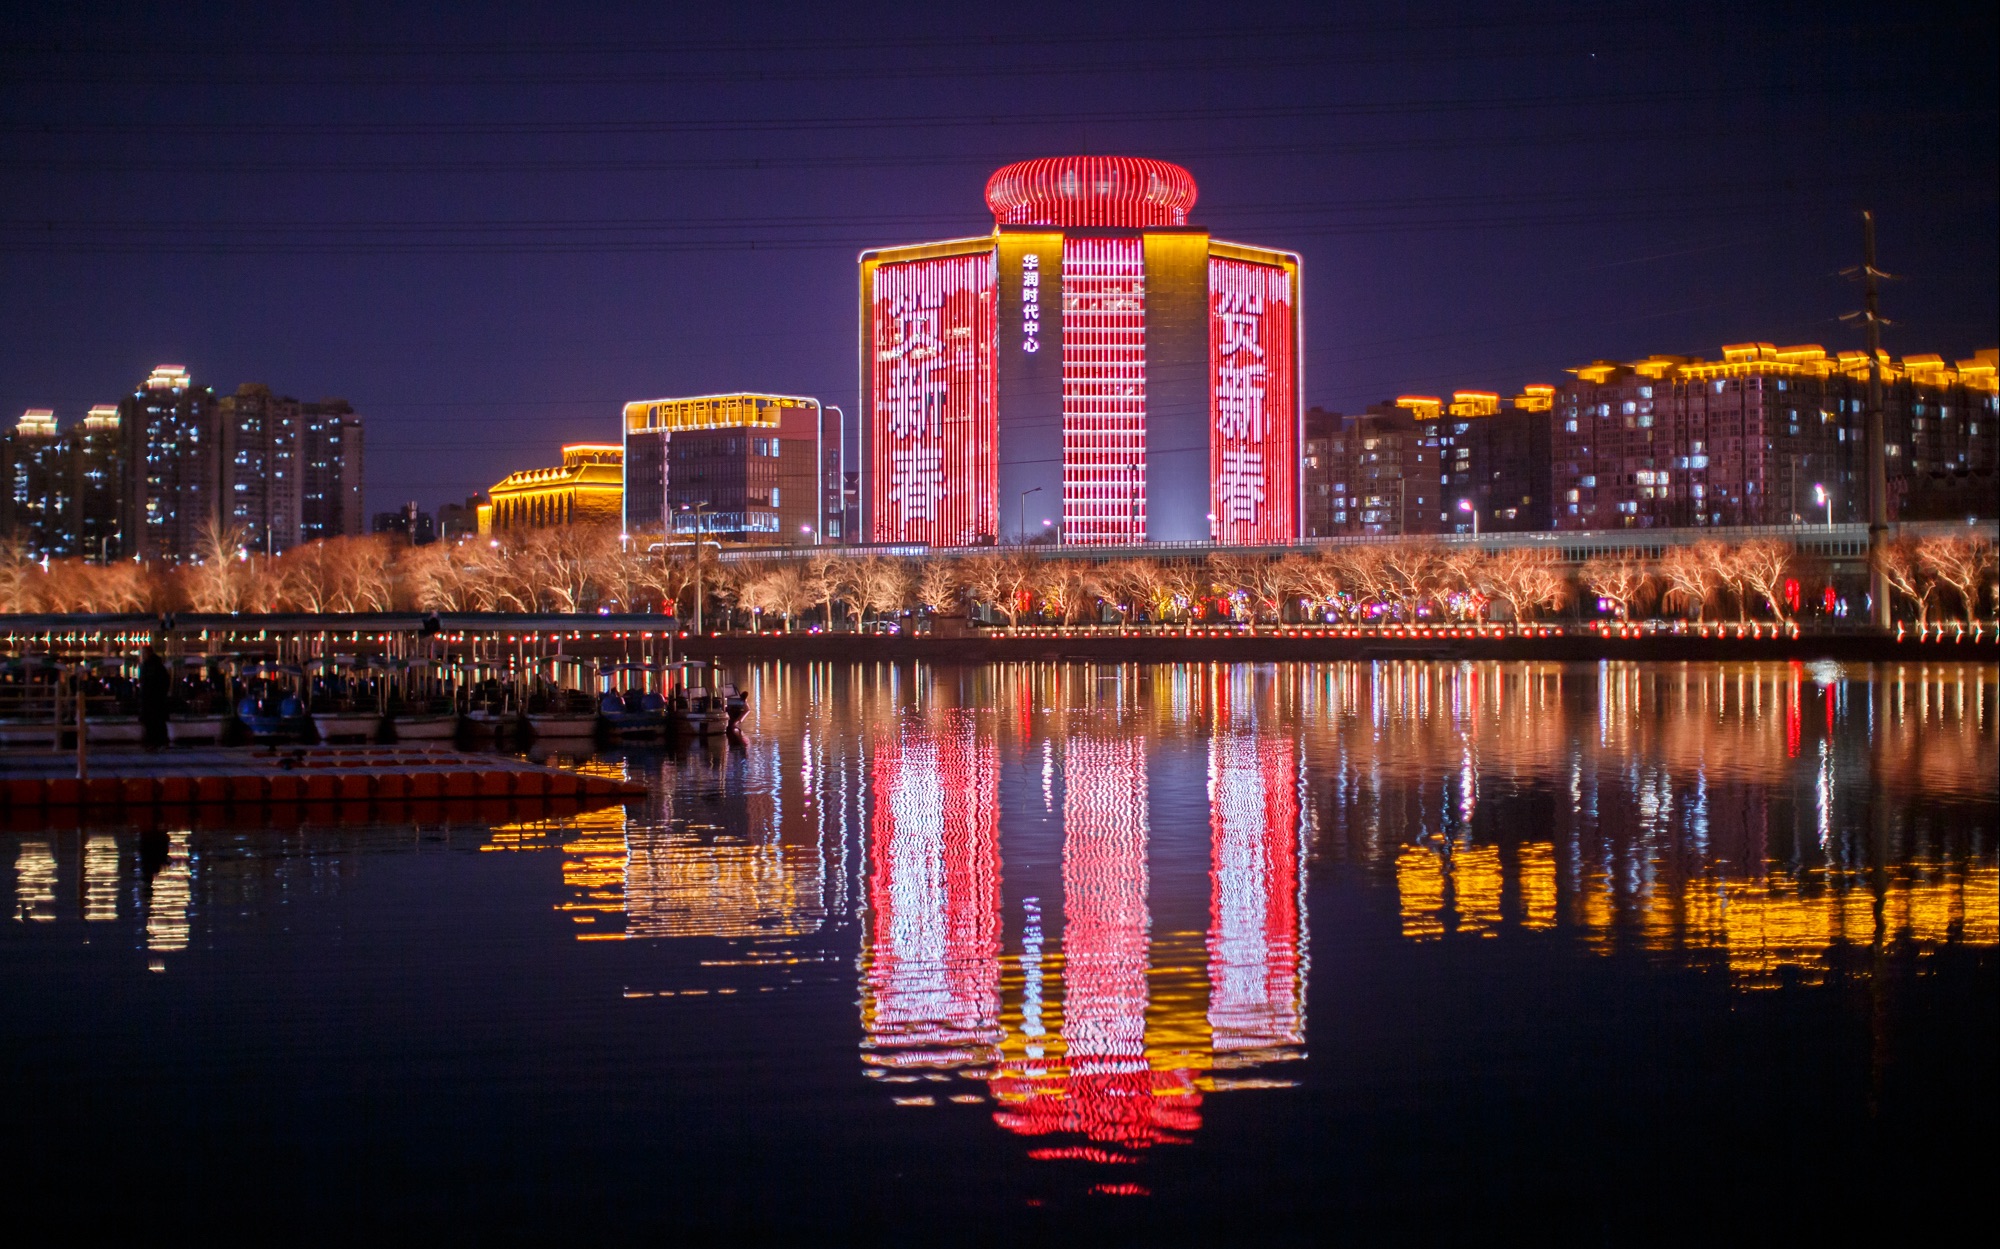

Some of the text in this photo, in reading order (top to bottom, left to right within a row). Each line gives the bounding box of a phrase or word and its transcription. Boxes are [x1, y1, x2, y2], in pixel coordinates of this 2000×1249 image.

[1022, 254, 1039, 353] 华润时代中心
